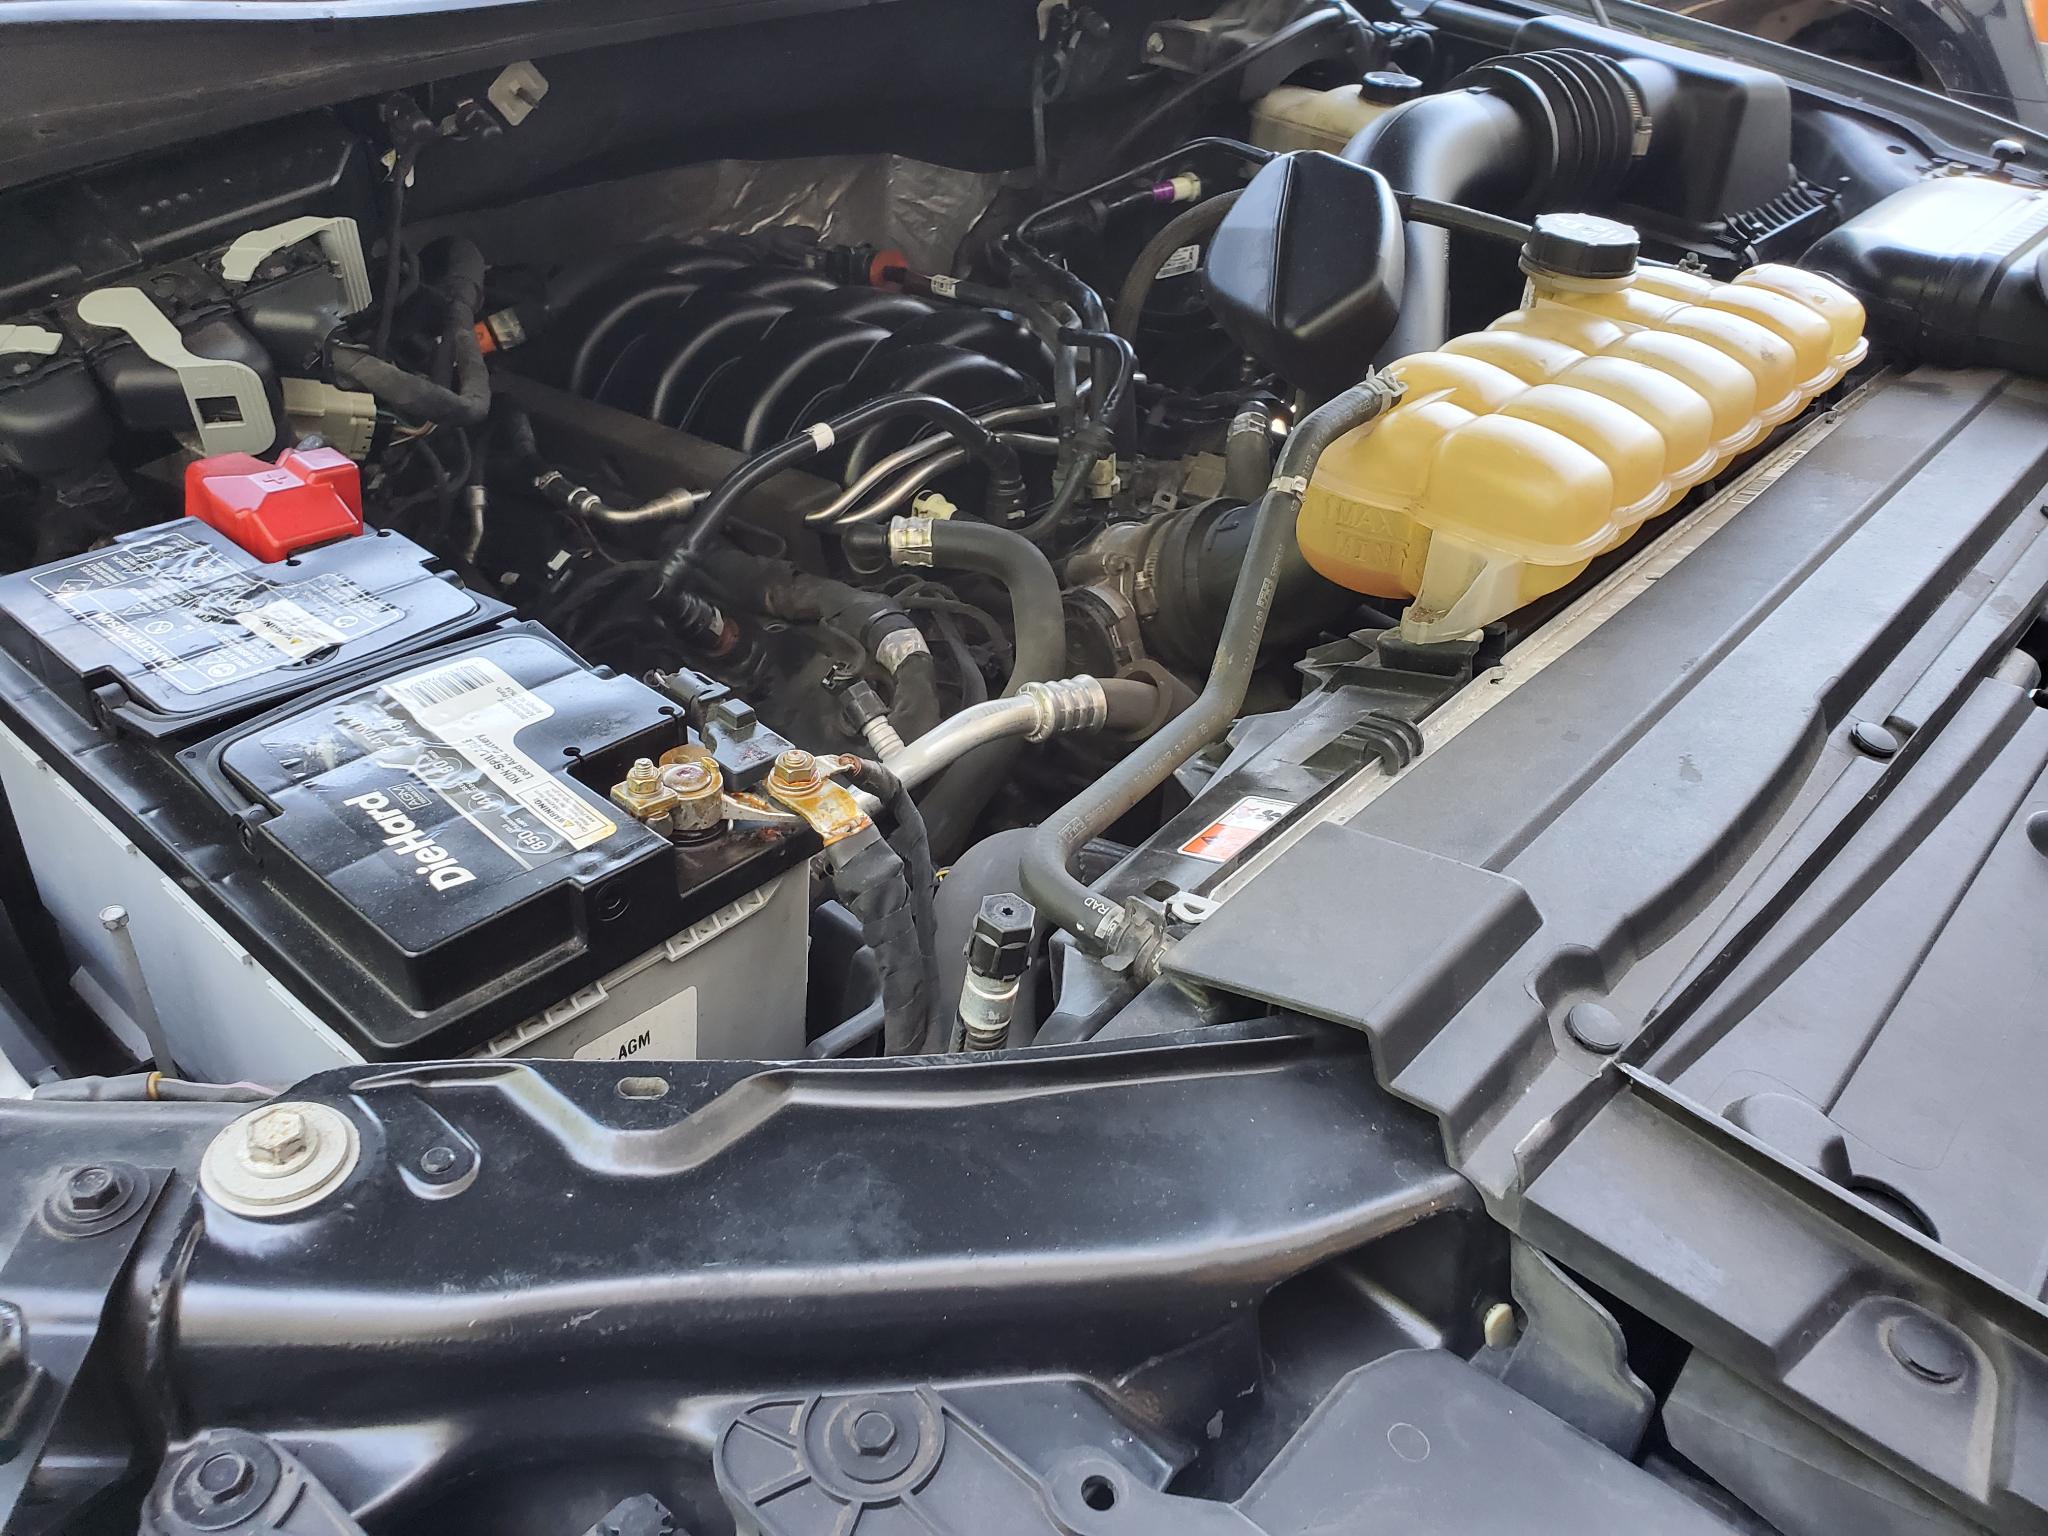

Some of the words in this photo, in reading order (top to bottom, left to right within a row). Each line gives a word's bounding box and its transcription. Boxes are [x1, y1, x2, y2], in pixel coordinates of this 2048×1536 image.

[1336, 498, 1394, 537] MAX
[511, 764, 535, 779] Lead
[390, 786, 421, 805] AGM
[470, 791, 499, 810] 140
[341, 790, 477, 891] DieHard
[516, 829, 547, 850] 850
[1084, 897, 1110, 915] RAD
